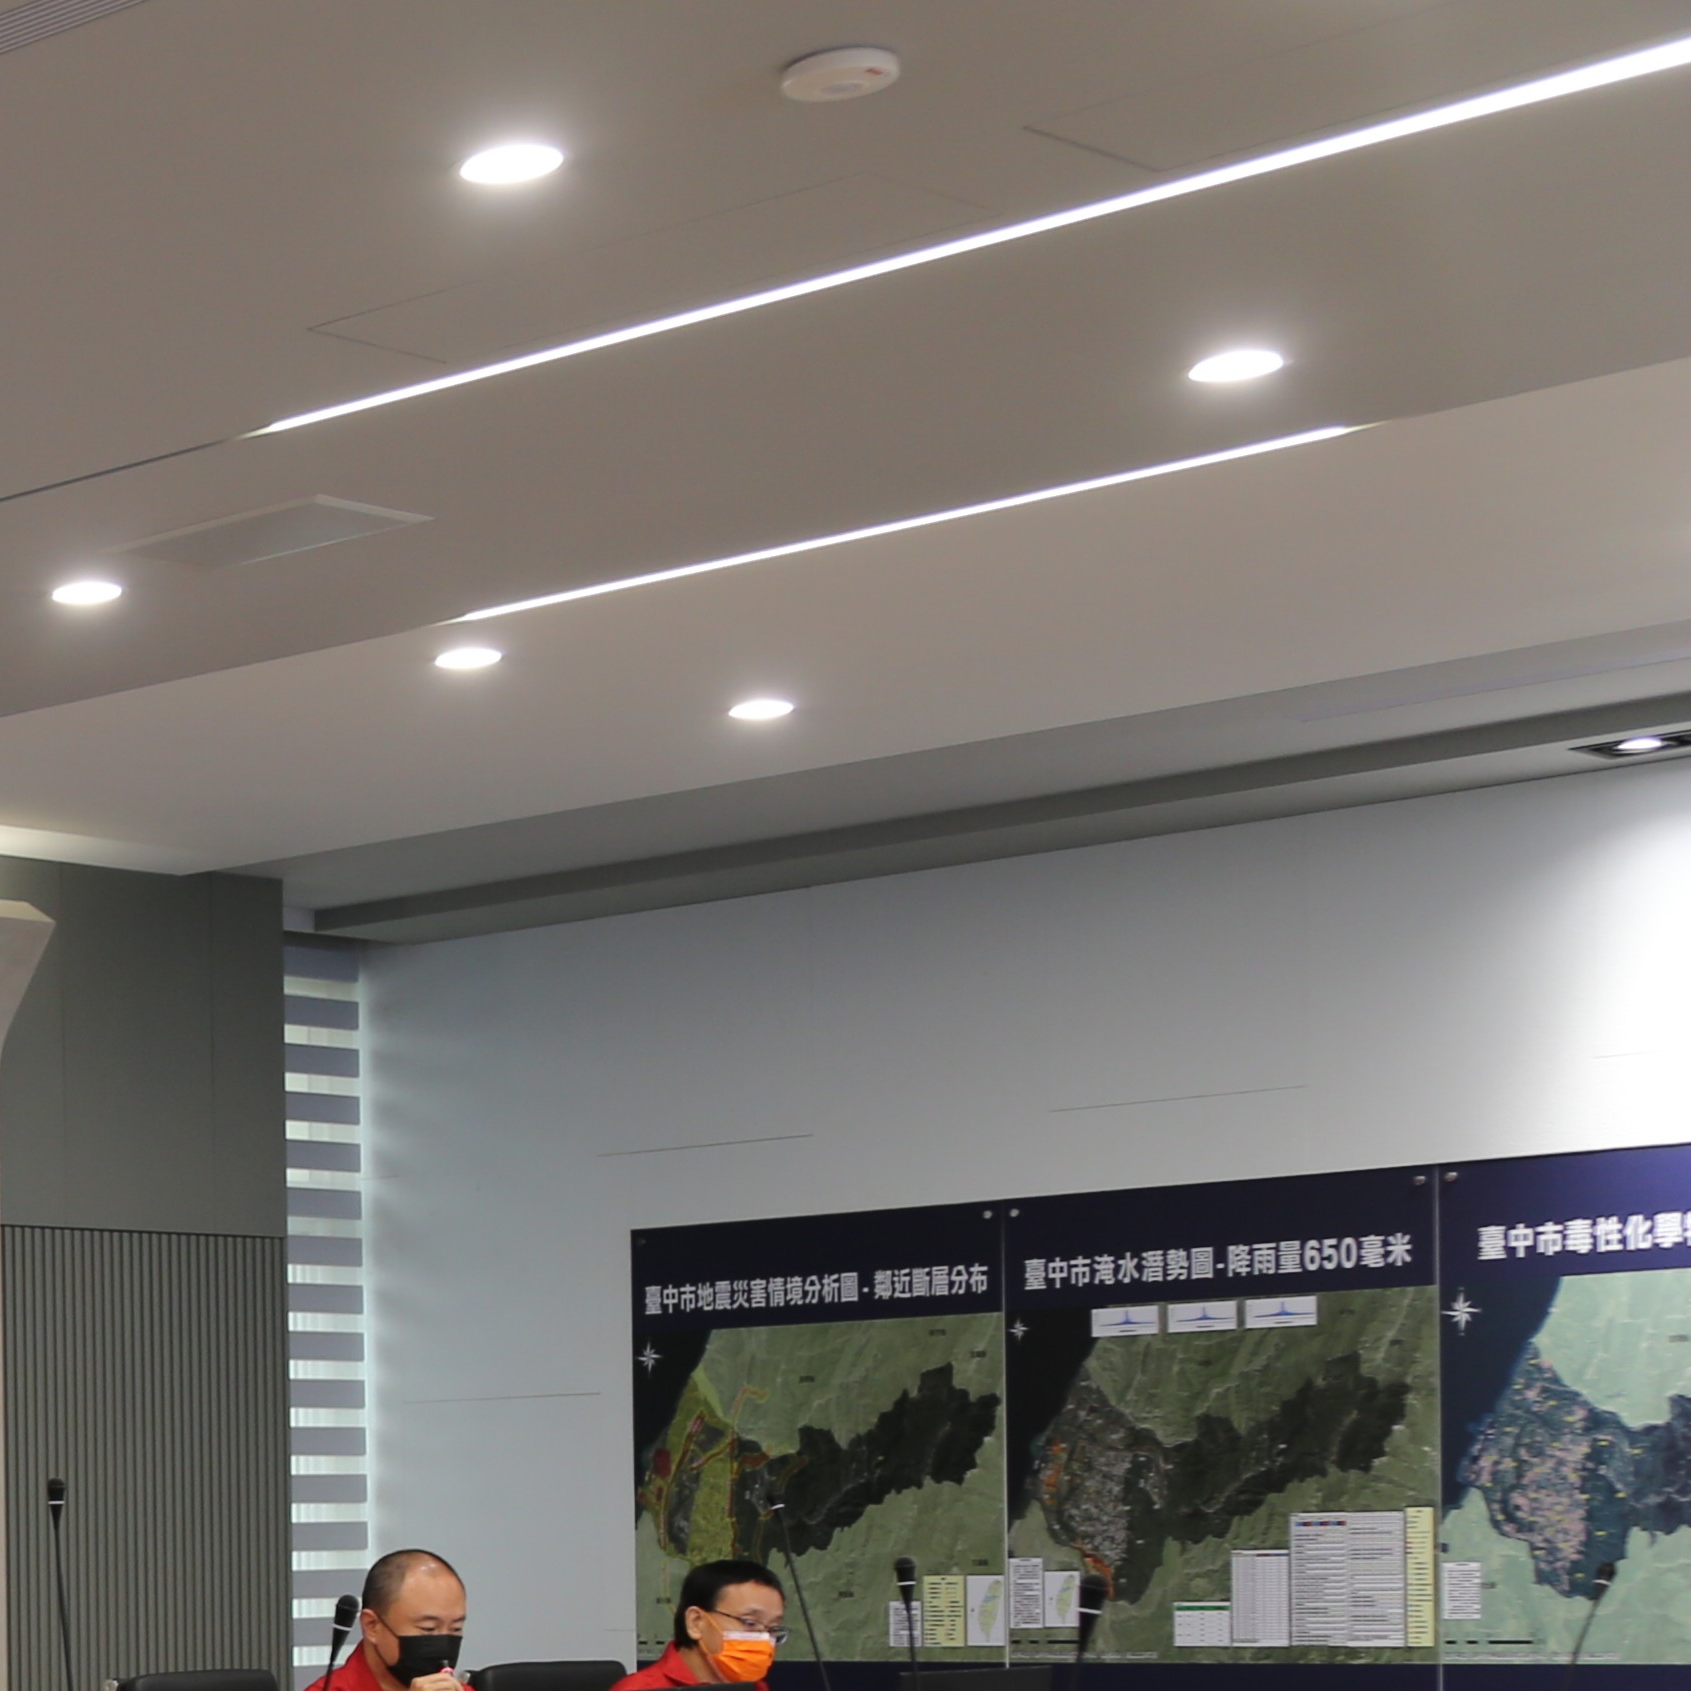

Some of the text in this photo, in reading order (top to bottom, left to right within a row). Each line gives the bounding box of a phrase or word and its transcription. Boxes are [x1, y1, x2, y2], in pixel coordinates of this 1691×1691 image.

[1477, 1210, 1691, 1261] 臺中市毒性化學
